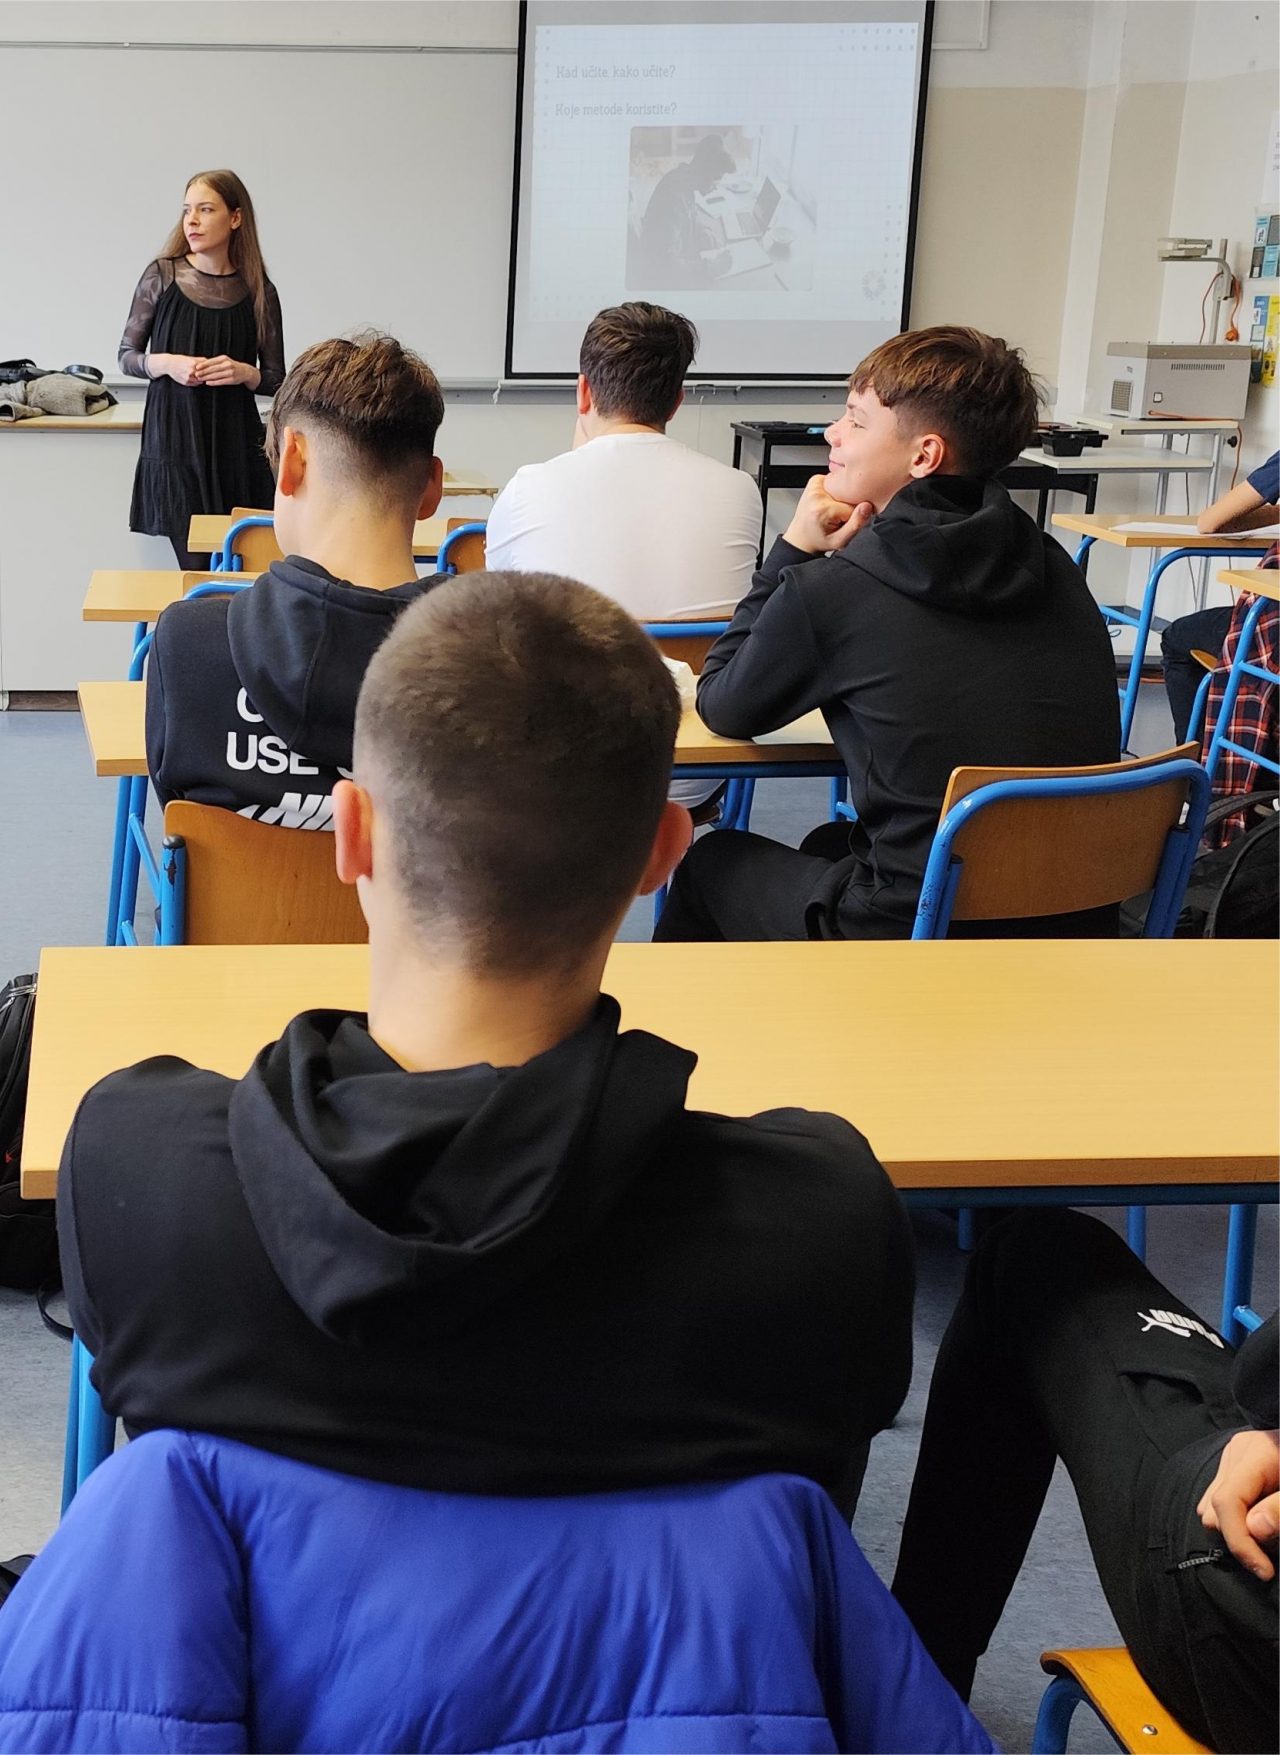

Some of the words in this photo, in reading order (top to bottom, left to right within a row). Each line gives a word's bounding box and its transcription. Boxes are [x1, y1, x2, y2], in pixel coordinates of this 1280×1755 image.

[556, 64, 578, 79] Kad
[612, 64, 640, 79] kako
[642, 64, 677, 79] učite?
[555, 103, 581, 120] Koje
[583, 103, 624, 116] metode
[625, 101, 678, 116] koristite?
